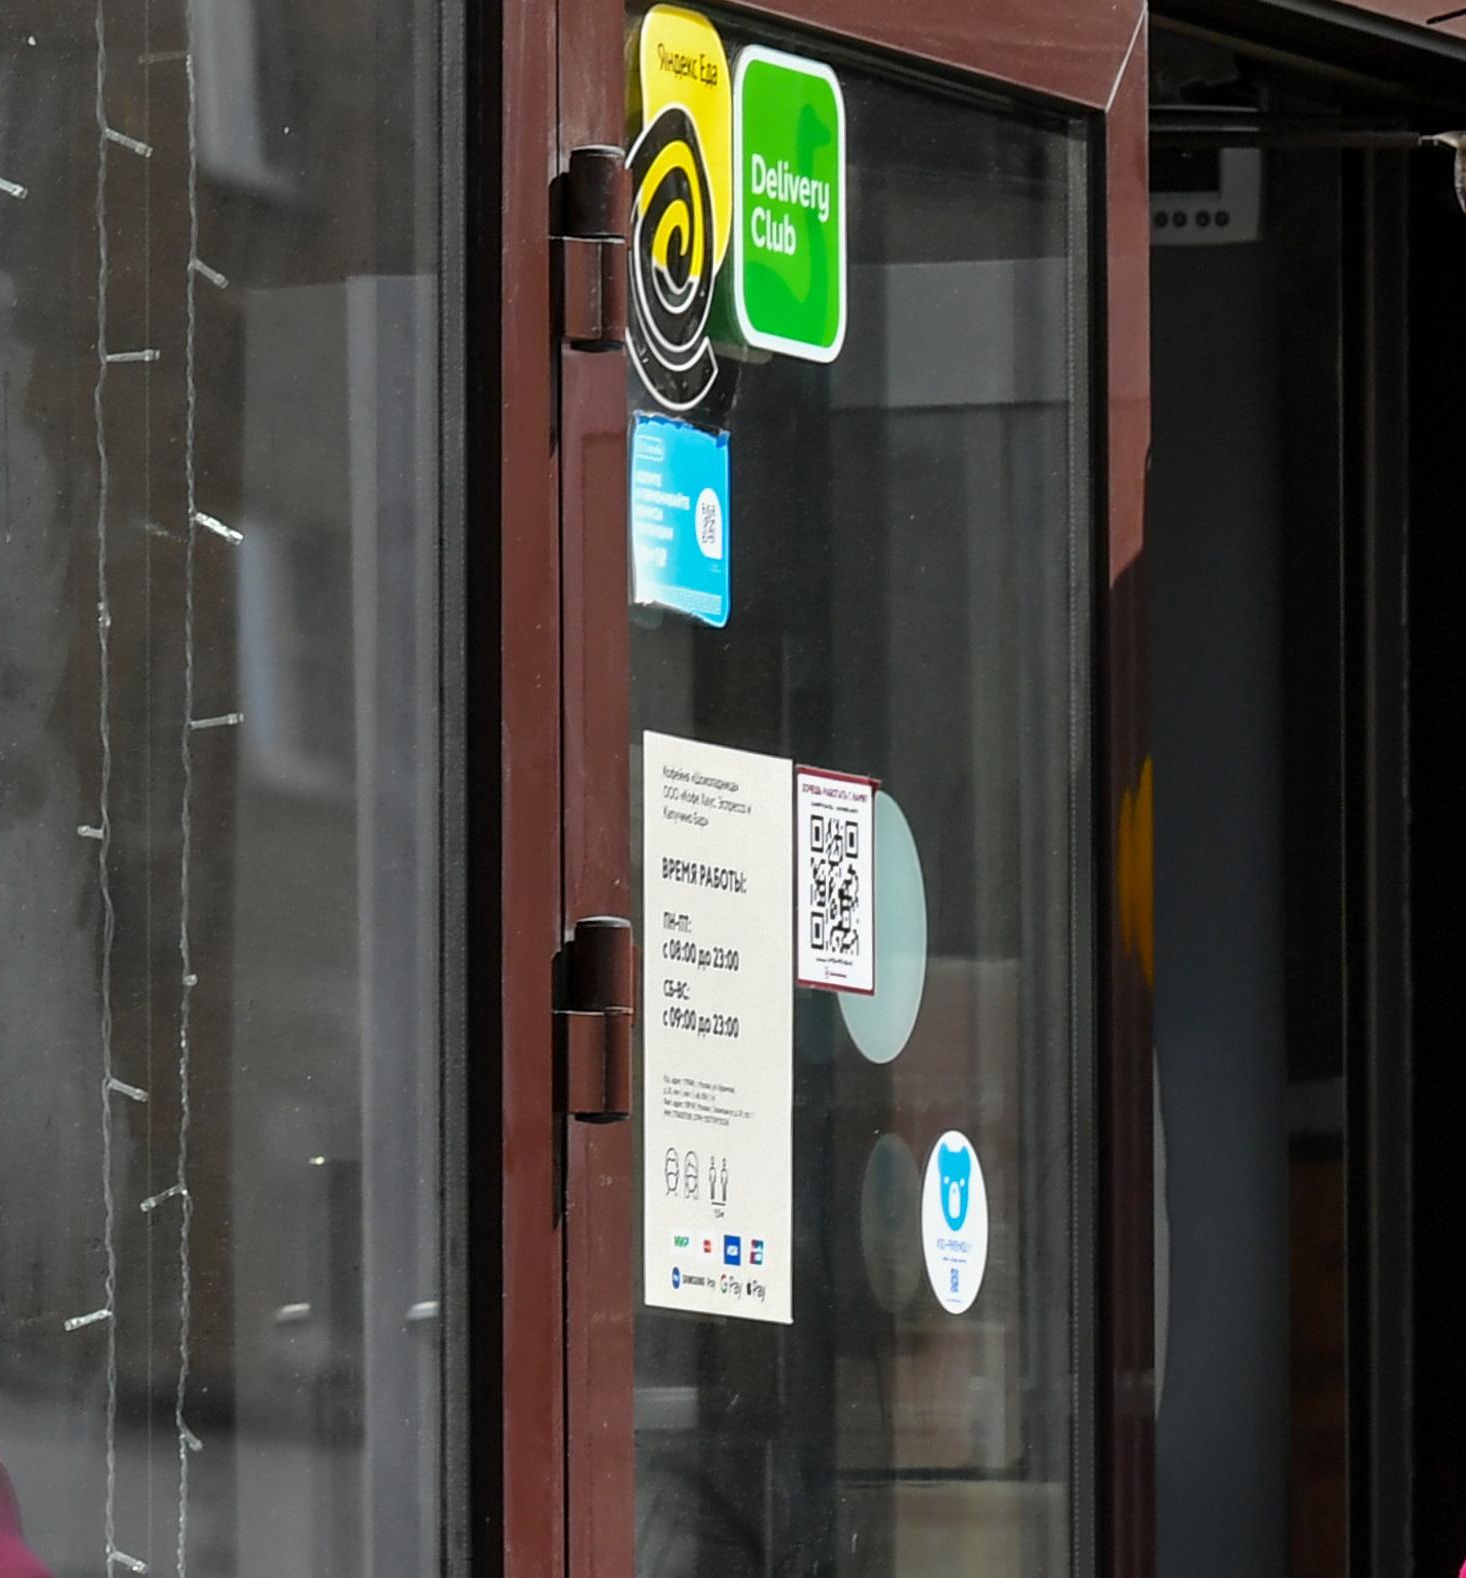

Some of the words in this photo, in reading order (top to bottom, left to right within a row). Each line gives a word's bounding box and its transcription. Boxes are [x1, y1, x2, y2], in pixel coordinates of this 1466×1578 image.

[657, 43, 698, 80] Яндекс
[699, 53, 718, 88] Еда
[751, 153, 830, 222] Delivery
[751, 206, 796, 255] Club
[662, 856, 697, 885] ВРЕМЯ
[699, 864, 747, 893] РАБОТЫ:
[669, 938, 696, 963] 08:00
[698, 949, 711, 970] до
[712, 946, 739, 971] 23:00
[669, 1006, 696, 1031] 09:00
[698, 1015, 711, 1038] до
[712, 1013, 739, 1038] 23:00
